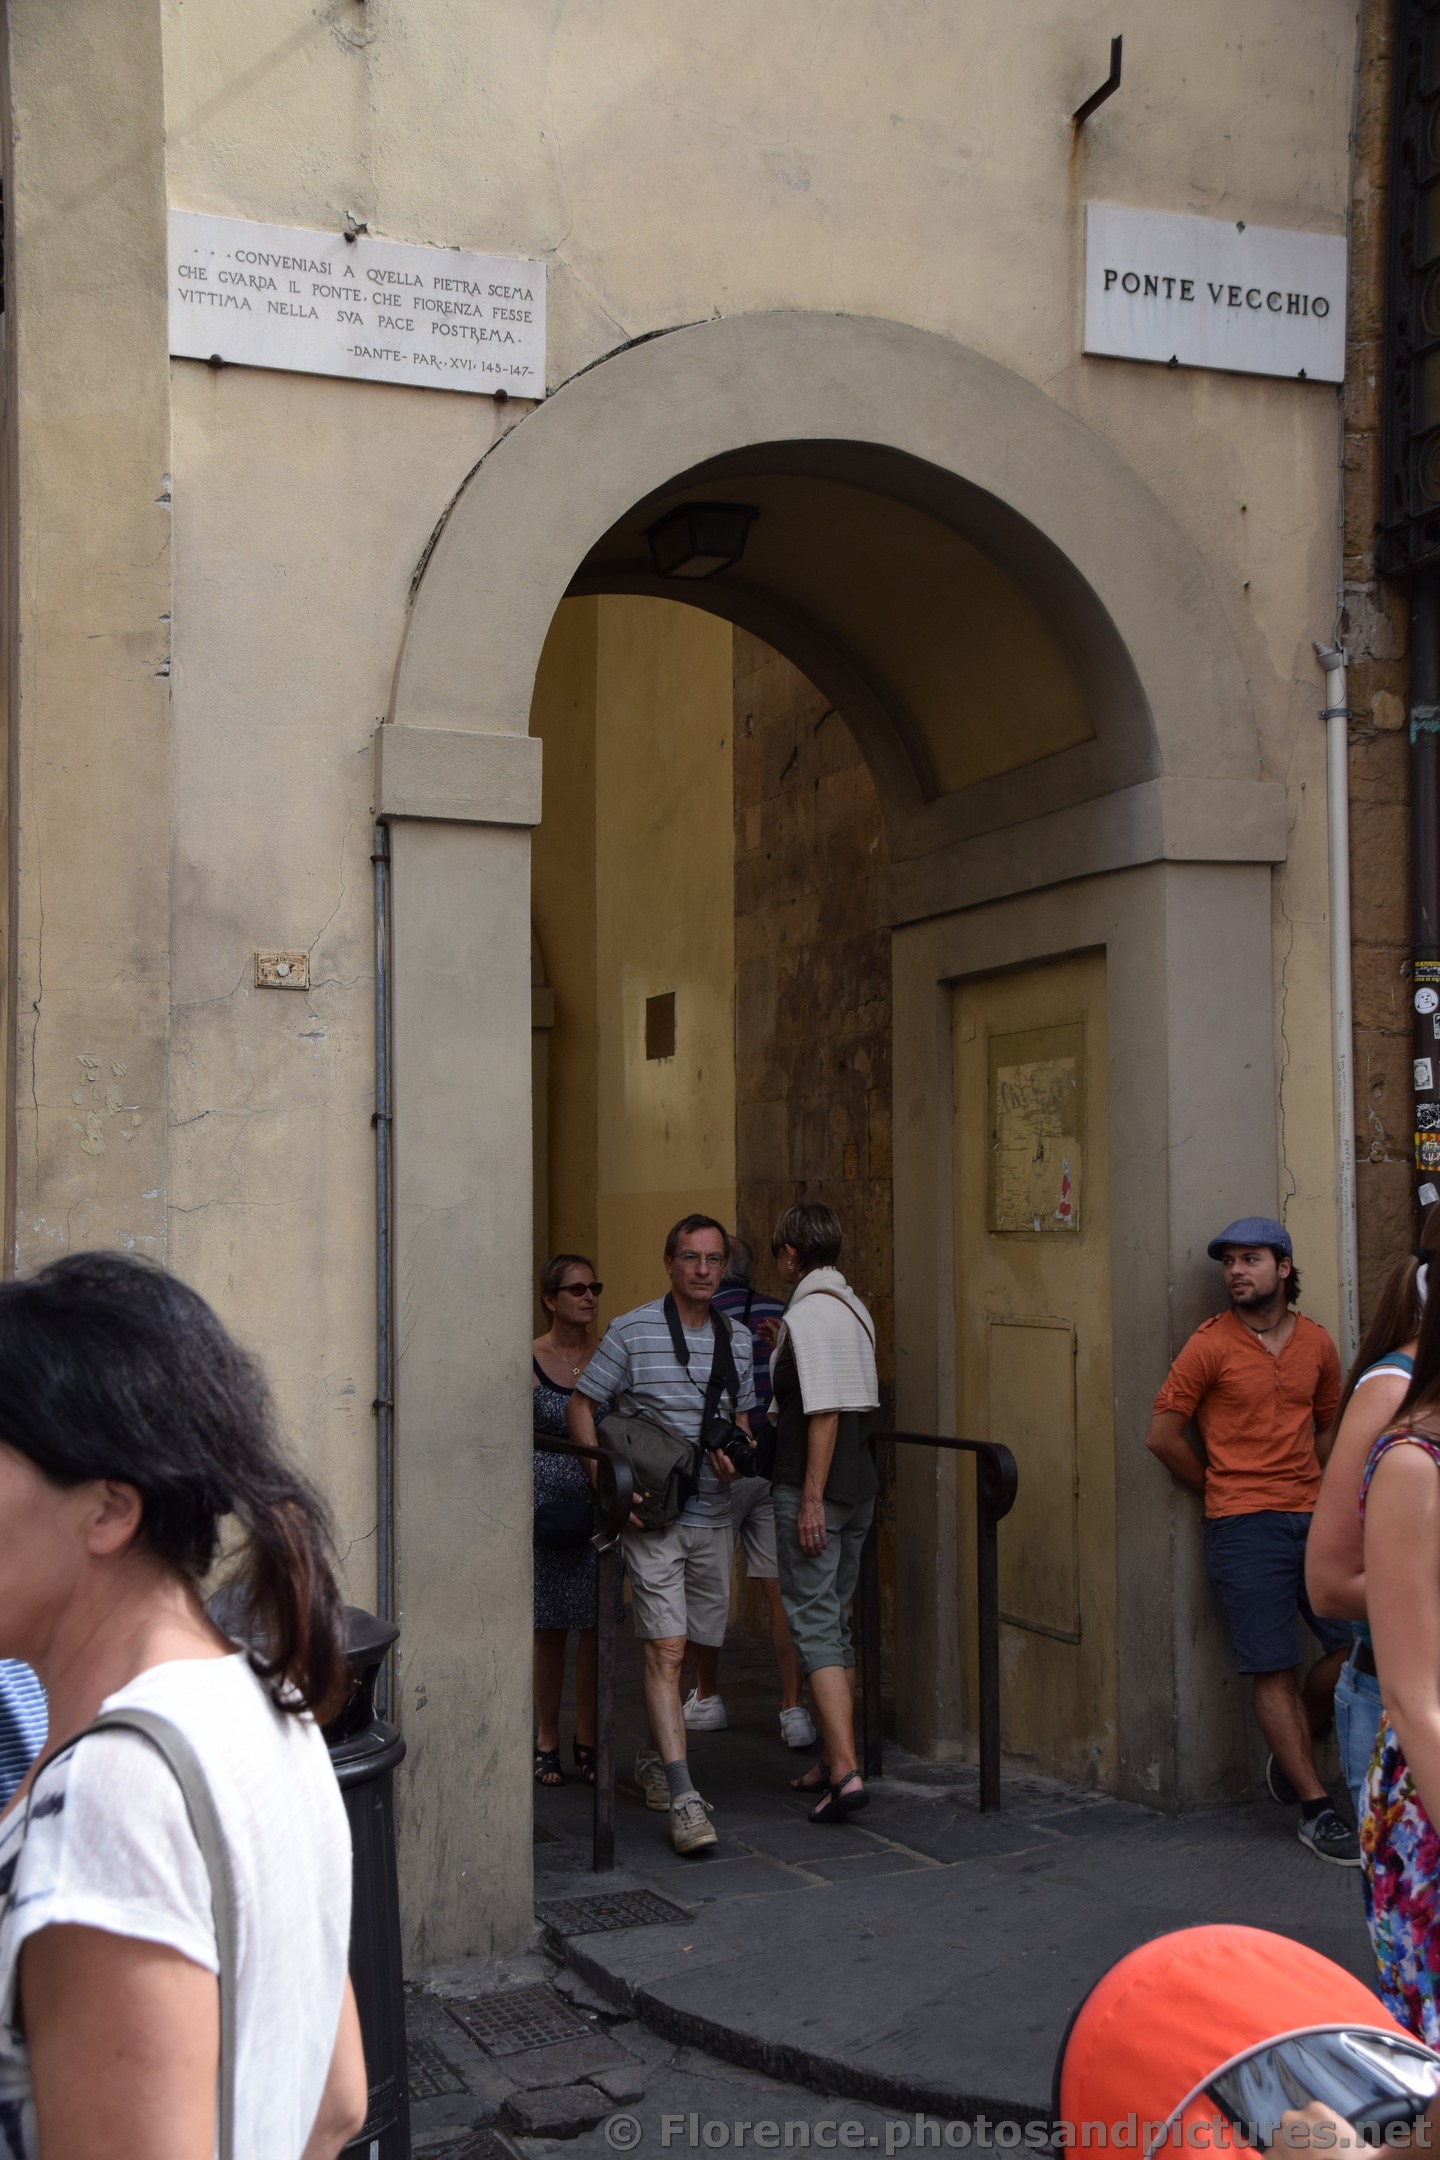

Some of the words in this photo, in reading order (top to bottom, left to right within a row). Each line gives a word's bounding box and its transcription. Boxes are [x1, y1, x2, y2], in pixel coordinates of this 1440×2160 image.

[178, 265, 208, 280] CHE
[218, 271, 277, 291] GVARDA
[289, 281, 301, 293] IL
[372, 292, 402, 307] CHE
[413, 298, 482, 318] FIORENZA
[492, 307, 533, 323] FESSE
[343, 265, 355, 278] A
[367, 268, 424, 287] QVELLA
[434, 277, 481, 296] PIETRA
[488, 284, 534, 301] SCEMA
[1104, 269, 1195, 302] PONTE
[1207, 283, 1330, 318] VECCHIO
[178, 288, 252, 310] VITTIMA
[267, 301, 319, 319] NELLA
[337, 311, 364, 325] SVA
[378, 316, 414, 331] PACE
